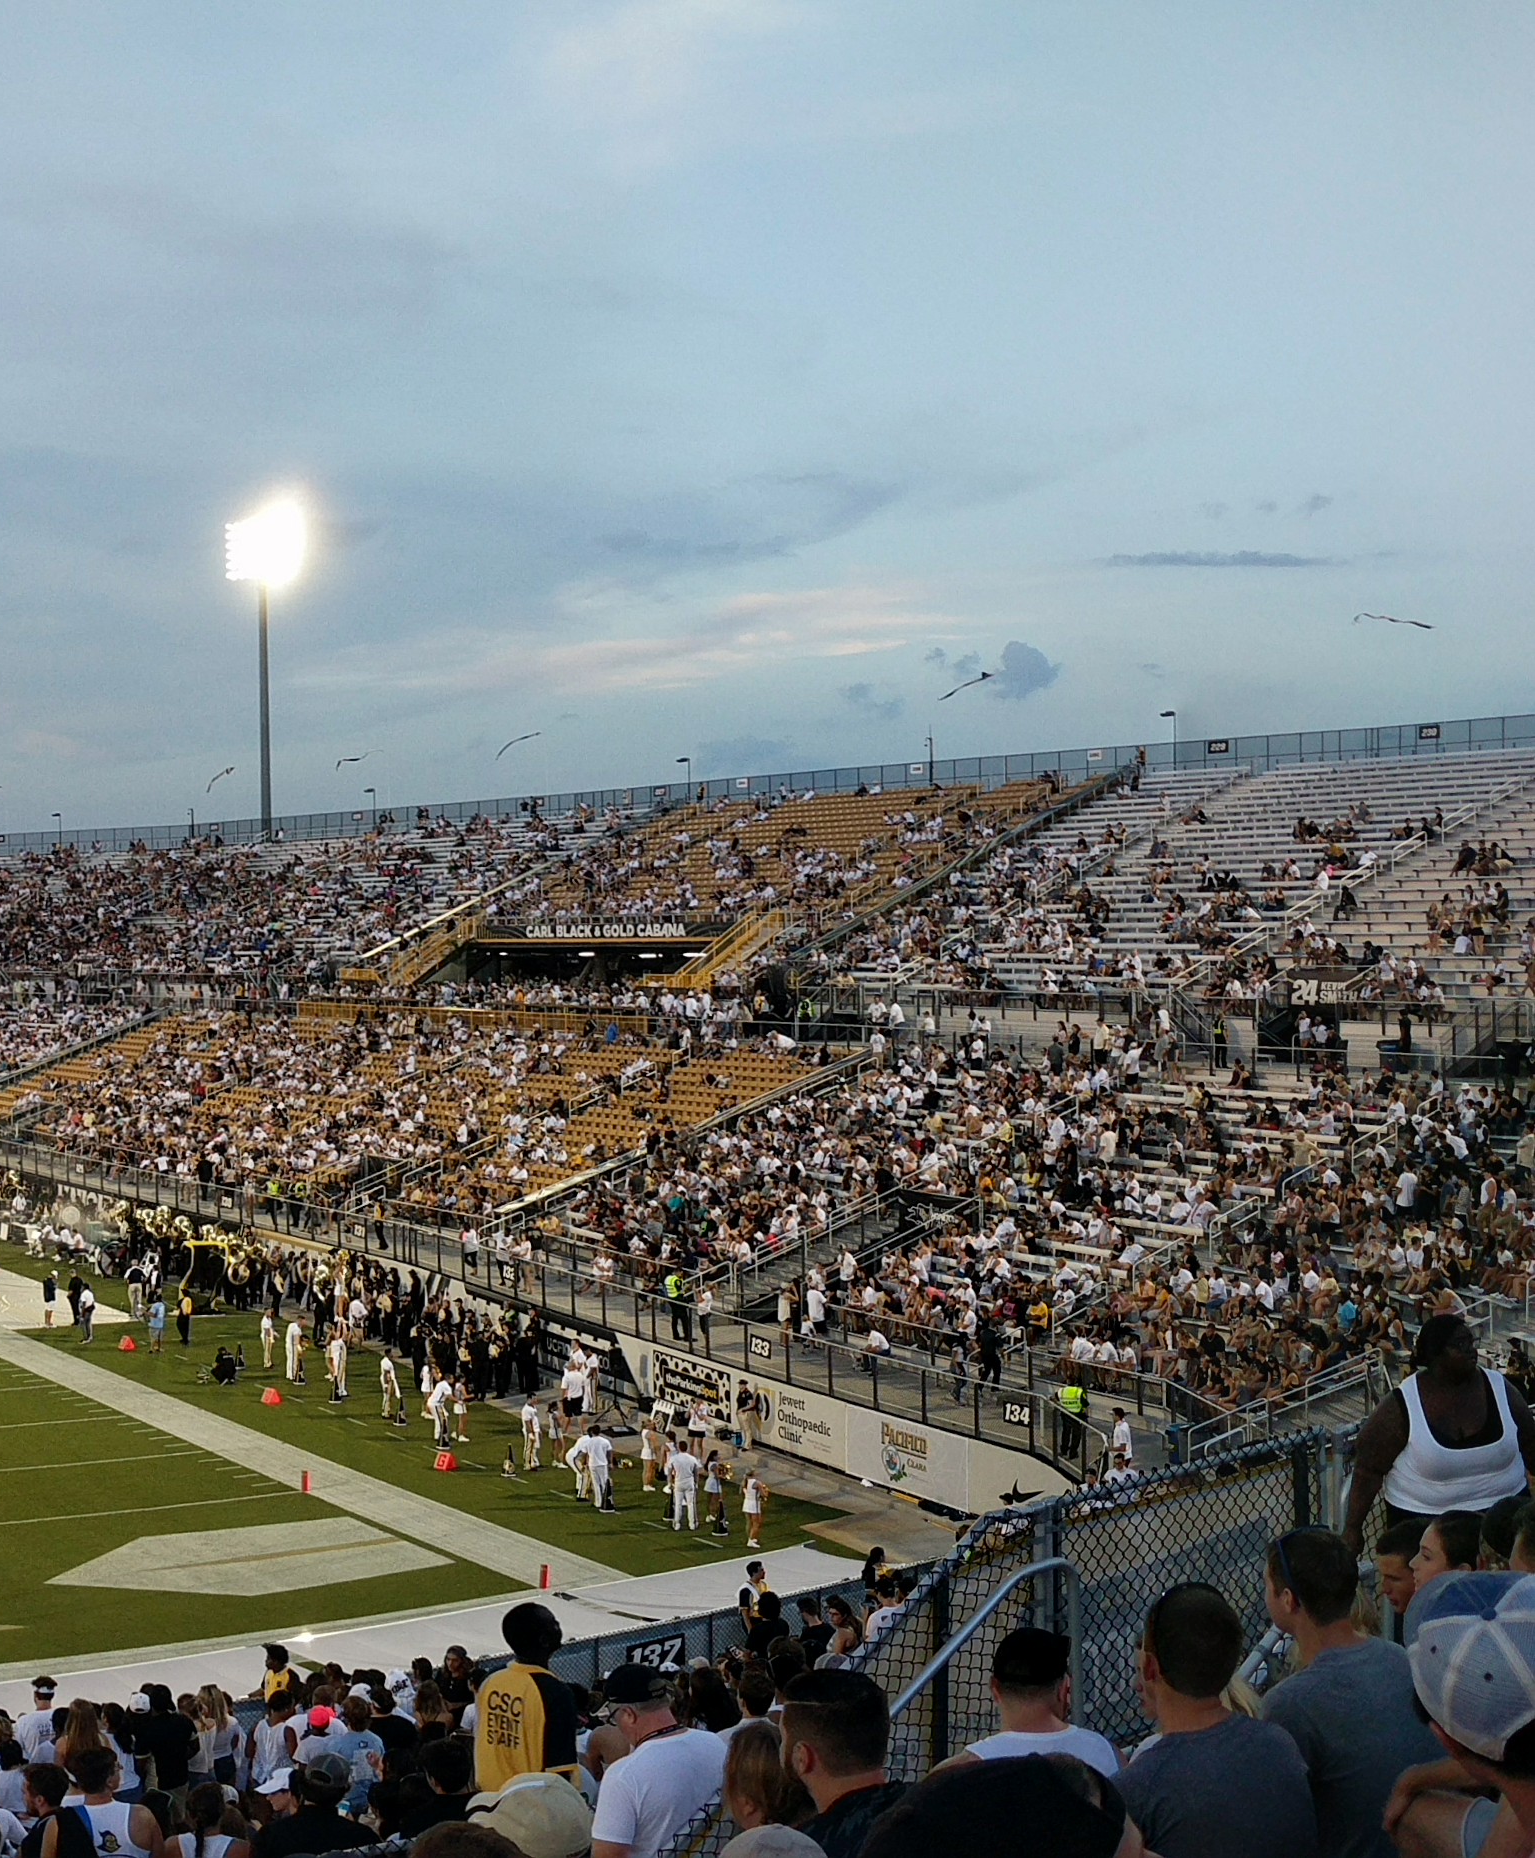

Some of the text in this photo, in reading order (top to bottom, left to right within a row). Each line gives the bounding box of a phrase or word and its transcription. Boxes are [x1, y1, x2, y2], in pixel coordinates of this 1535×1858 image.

[526, 923, 686, 938] CARL BLACK & GOLD CABANA
[1291, 979, 1319, 1006] 24
[502, 1264, 516, 1281] 132
[750, 1337, 770, 1357] 133
[665, 1370, 719, 1400] theParkingSpot
[778, 1391, 805, 1411] Jewett
[777, 1409, 831, 1438] Orthopaedic
[1004, 1402, 1030, 1426] 134
[778, 1426, 803, 1446] Clinic
[906, 1457, 928, 1473] CLARA
[630, 1637, 682, 1667] 137
[487, 1689, 524, 1718] CSC
[487, 1712, 521, 1734] EVENT
[487, 1728, 521, 1751] STAFF
